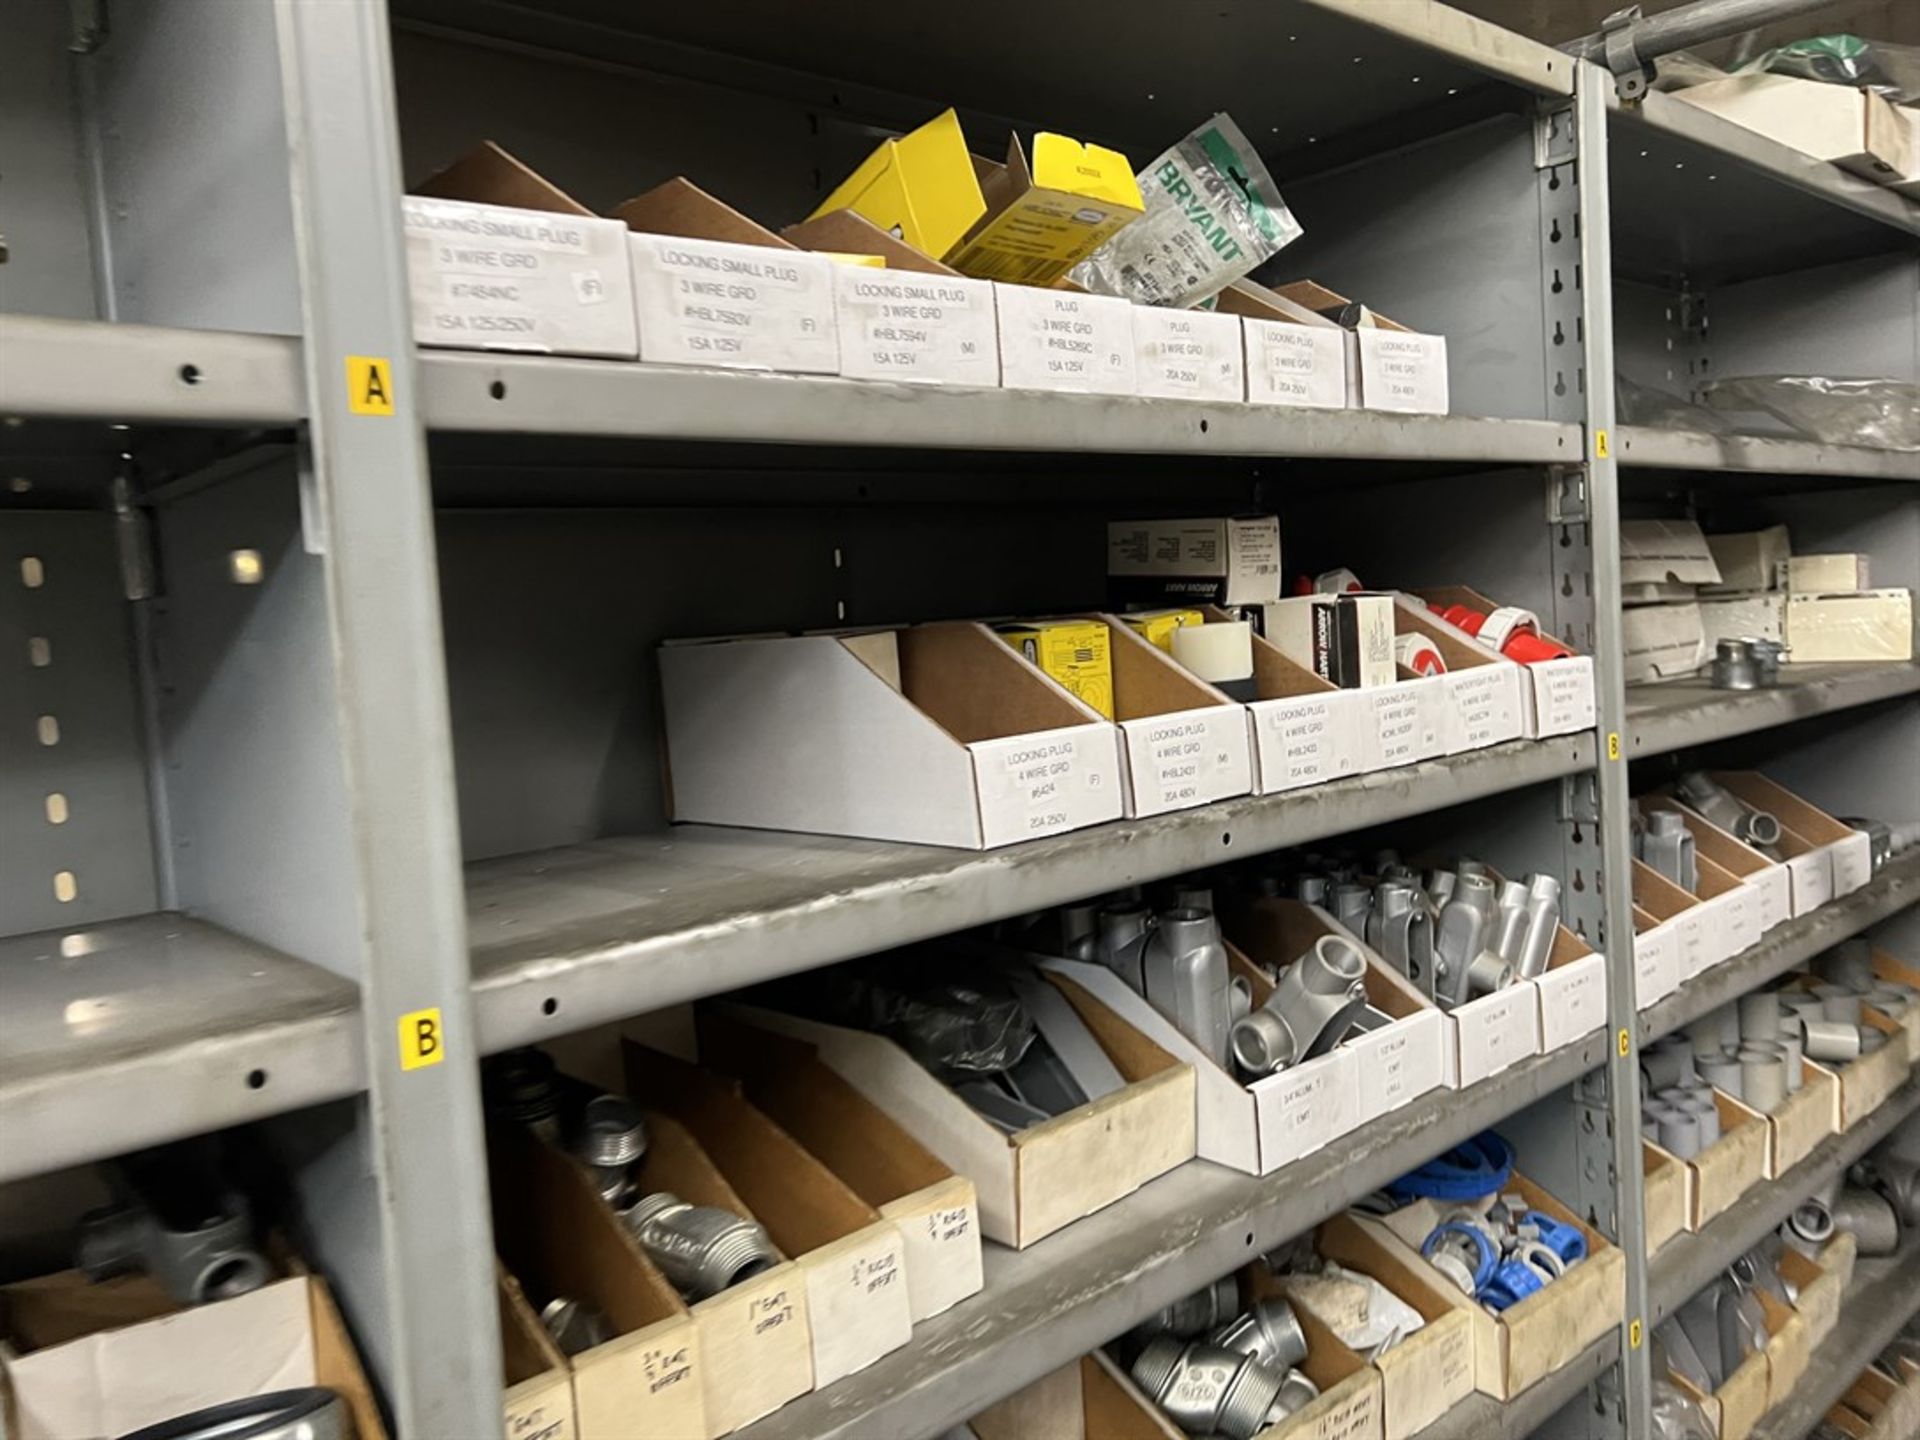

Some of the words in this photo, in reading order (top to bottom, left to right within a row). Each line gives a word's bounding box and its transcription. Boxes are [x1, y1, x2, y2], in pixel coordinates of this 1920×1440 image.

[1155, 160, 1243, 262] BRYANT
[481, 221, 535, 241] SMALL
[538, 228, 581, 246] PLUG
[440, 248, 452, 264] 3
[458, 250, 498, 267] WIRE
[500, 253, 539, 269] GRD
[660, 250, 720, 271] LOCKING
[721, 260, 762, 277] SMALL
[764, 267, 799, 282] PLUG
[680, 280, 689, 293] 3
[693, 281, 725, 297] WIRE
[728, 286, 756, 300] GRD
[855, 284, 902, 299] LOCKING
[904, 287, 936, 300] SMALL
[938, 289, 965, 302] PLUG
[882, 306, 889, 317] 3
[892, 306, 917, 318] WIRE
[919, 307, 942, 319] GRD
[1055, 299, 1078, 312] PLUG
[435, 315, 465, 331] 15A
[801, 318, 816, 332] (F)
[1043, 319, 1049, 330] 3
[1050, 320, 1072, 333] WIRE
[1073, 322, 1093, 334] GRD
[1170, 321, 1190, 333] PLUG
[688, 337, 711, 350] 15A
[714, 338, 743, 351] 125V
[1267, 331, 1295, 344] LOCKING
[1296, 336, 1313, 348] PLUG
[1167, 343, 1185, 355] WIRE
[873, 352, 891, 364] 15A
[892, 353, 916, 364] 125V
[1110, 353, 1121, 366] (F)
[1281, 358, 1296, 368] WIRE
[1048, 361, 1062, 371] 15A
[1065, 361, 1084, 372] 125V
[365, 365, 388, 404] A
[1318, 606, 1328, 648] ARROW
[1277, 708, 1306, 721] LOCKING
[1307, 704, 1326, 716] PLUG
[1150, 726, 1184, 742] LOCKING
[1185, 723, 1205, 734] PLUG
[1291, 725, 1307, 737] WIRE
[1007, 748, 1047, 765] LOCKING
[1049, 742, 1073, 756] PLUG
[1164, 745, 1181, 757] WIRE
[1183, 742, 1200, 754] GRD
[1026, 765, 1048, 779] WIRE
[1050, 761, 1070, 775] GRD
[1089, 774, 1100, 785] (F)
[418, 1019, 437, 1056] B
